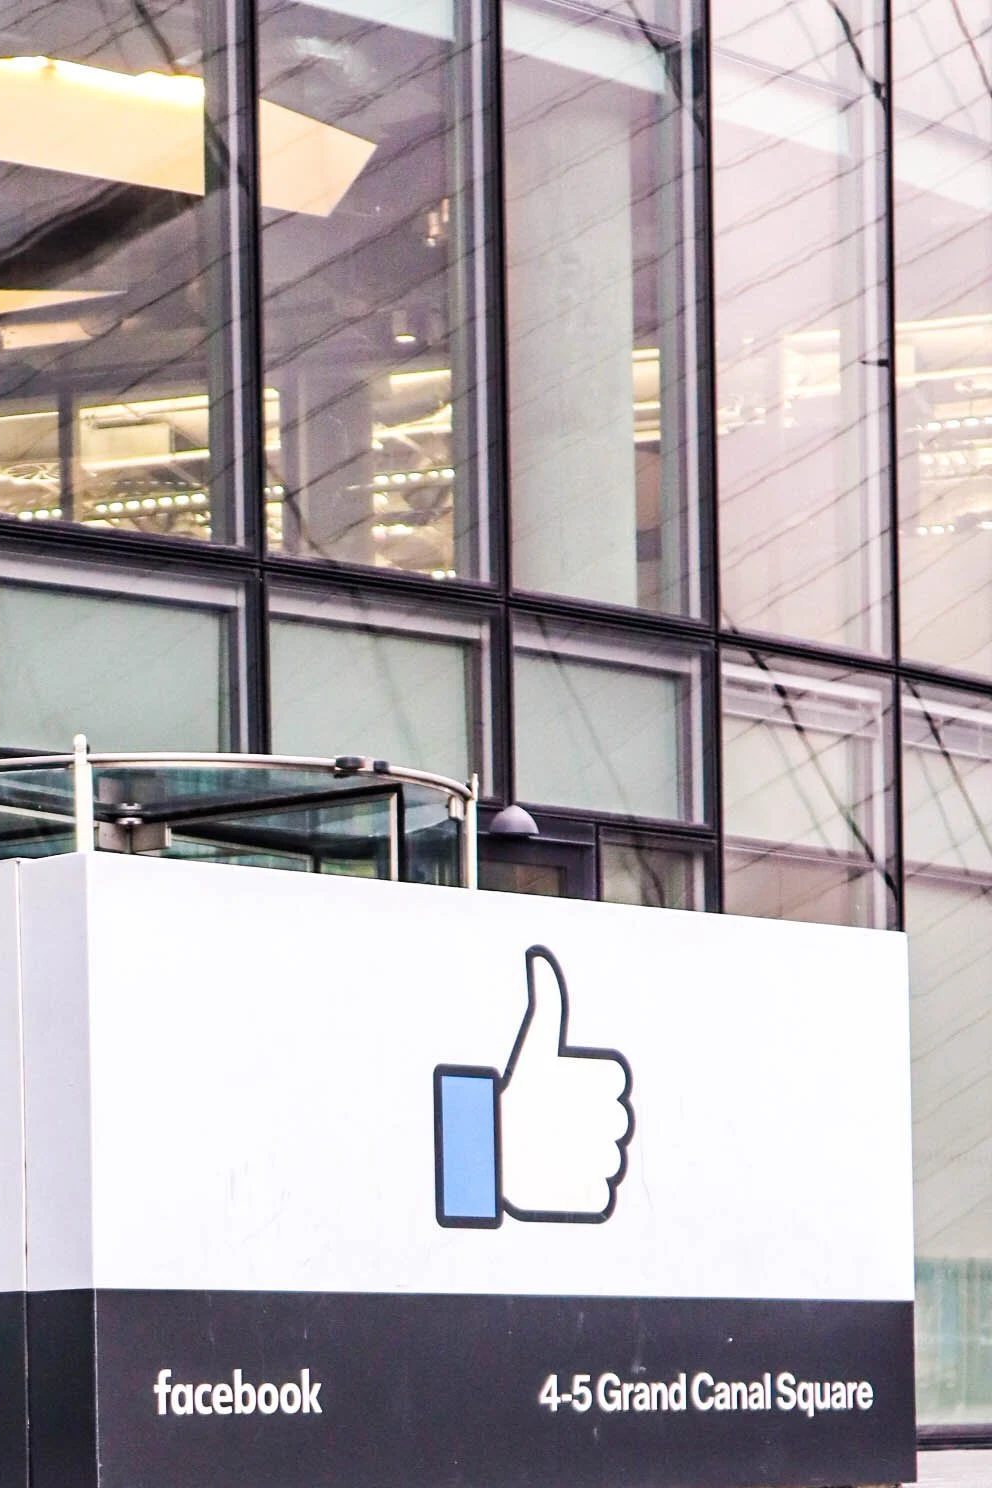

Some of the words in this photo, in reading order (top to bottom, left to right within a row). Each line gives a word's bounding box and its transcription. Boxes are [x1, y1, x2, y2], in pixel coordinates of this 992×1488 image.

[153, 1368, 323, 1415] facebook
[539, 1373, 593, 1412] 4-5
[597, 1372, 687, 1412] Grand
[690, 1371, 772, 1411] Canal
[775, 1371, 874, 1418] Square
